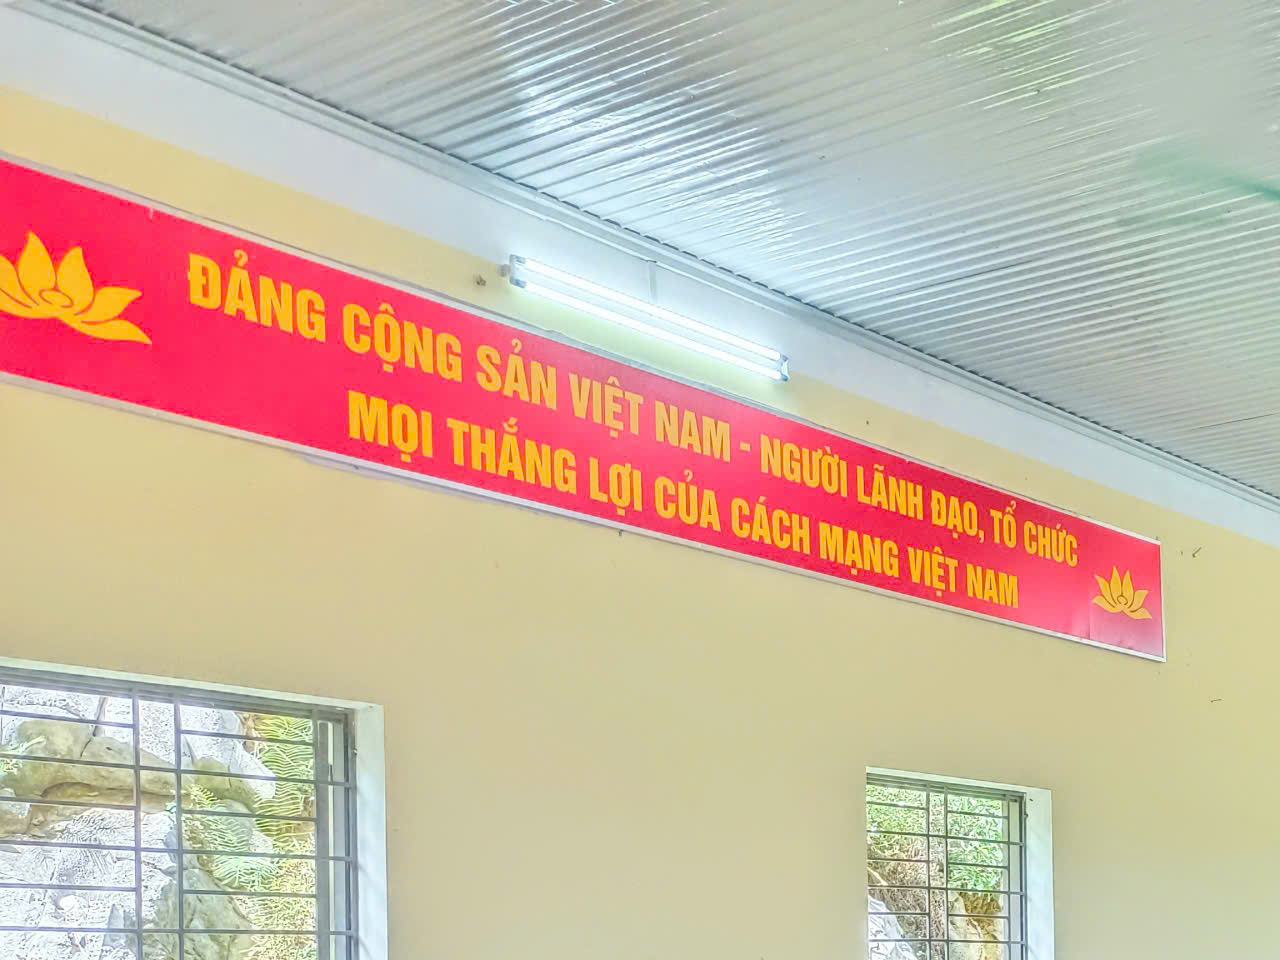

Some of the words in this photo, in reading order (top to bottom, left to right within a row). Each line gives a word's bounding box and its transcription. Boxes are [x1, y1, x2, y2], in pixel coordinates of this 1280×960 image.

[187, 249, 326, 342] ĐẢNG
[342, 303, 462, 382] CỘNG
[476, 339, 557, 410] SẢN
[568, 376, 645, 438] VIỆT
[655, 400, 731, 462] NAM
[760, 434, 848, 498] NGƯỜI
[856, 463, 924, 521] LÃNH
[931, 489, 985, 543] ĐẠO,
[990, 500, 1017, 548] TỔ
[1023, 520, 1078, 567] CHỨC
[348, 390, 433, 462] MỌI
[447, 416, 576, 494] THẮNG
[589, 456, 643, 516] LỢI
[654, 469, 721, 532] CỦA
[731, 495, 810, 555] CÁCH
[818, 522, 899, 575] MẠNG
[907, 545, 958, 597] VIỆT
[966, 564, 1019, 609] NAM
